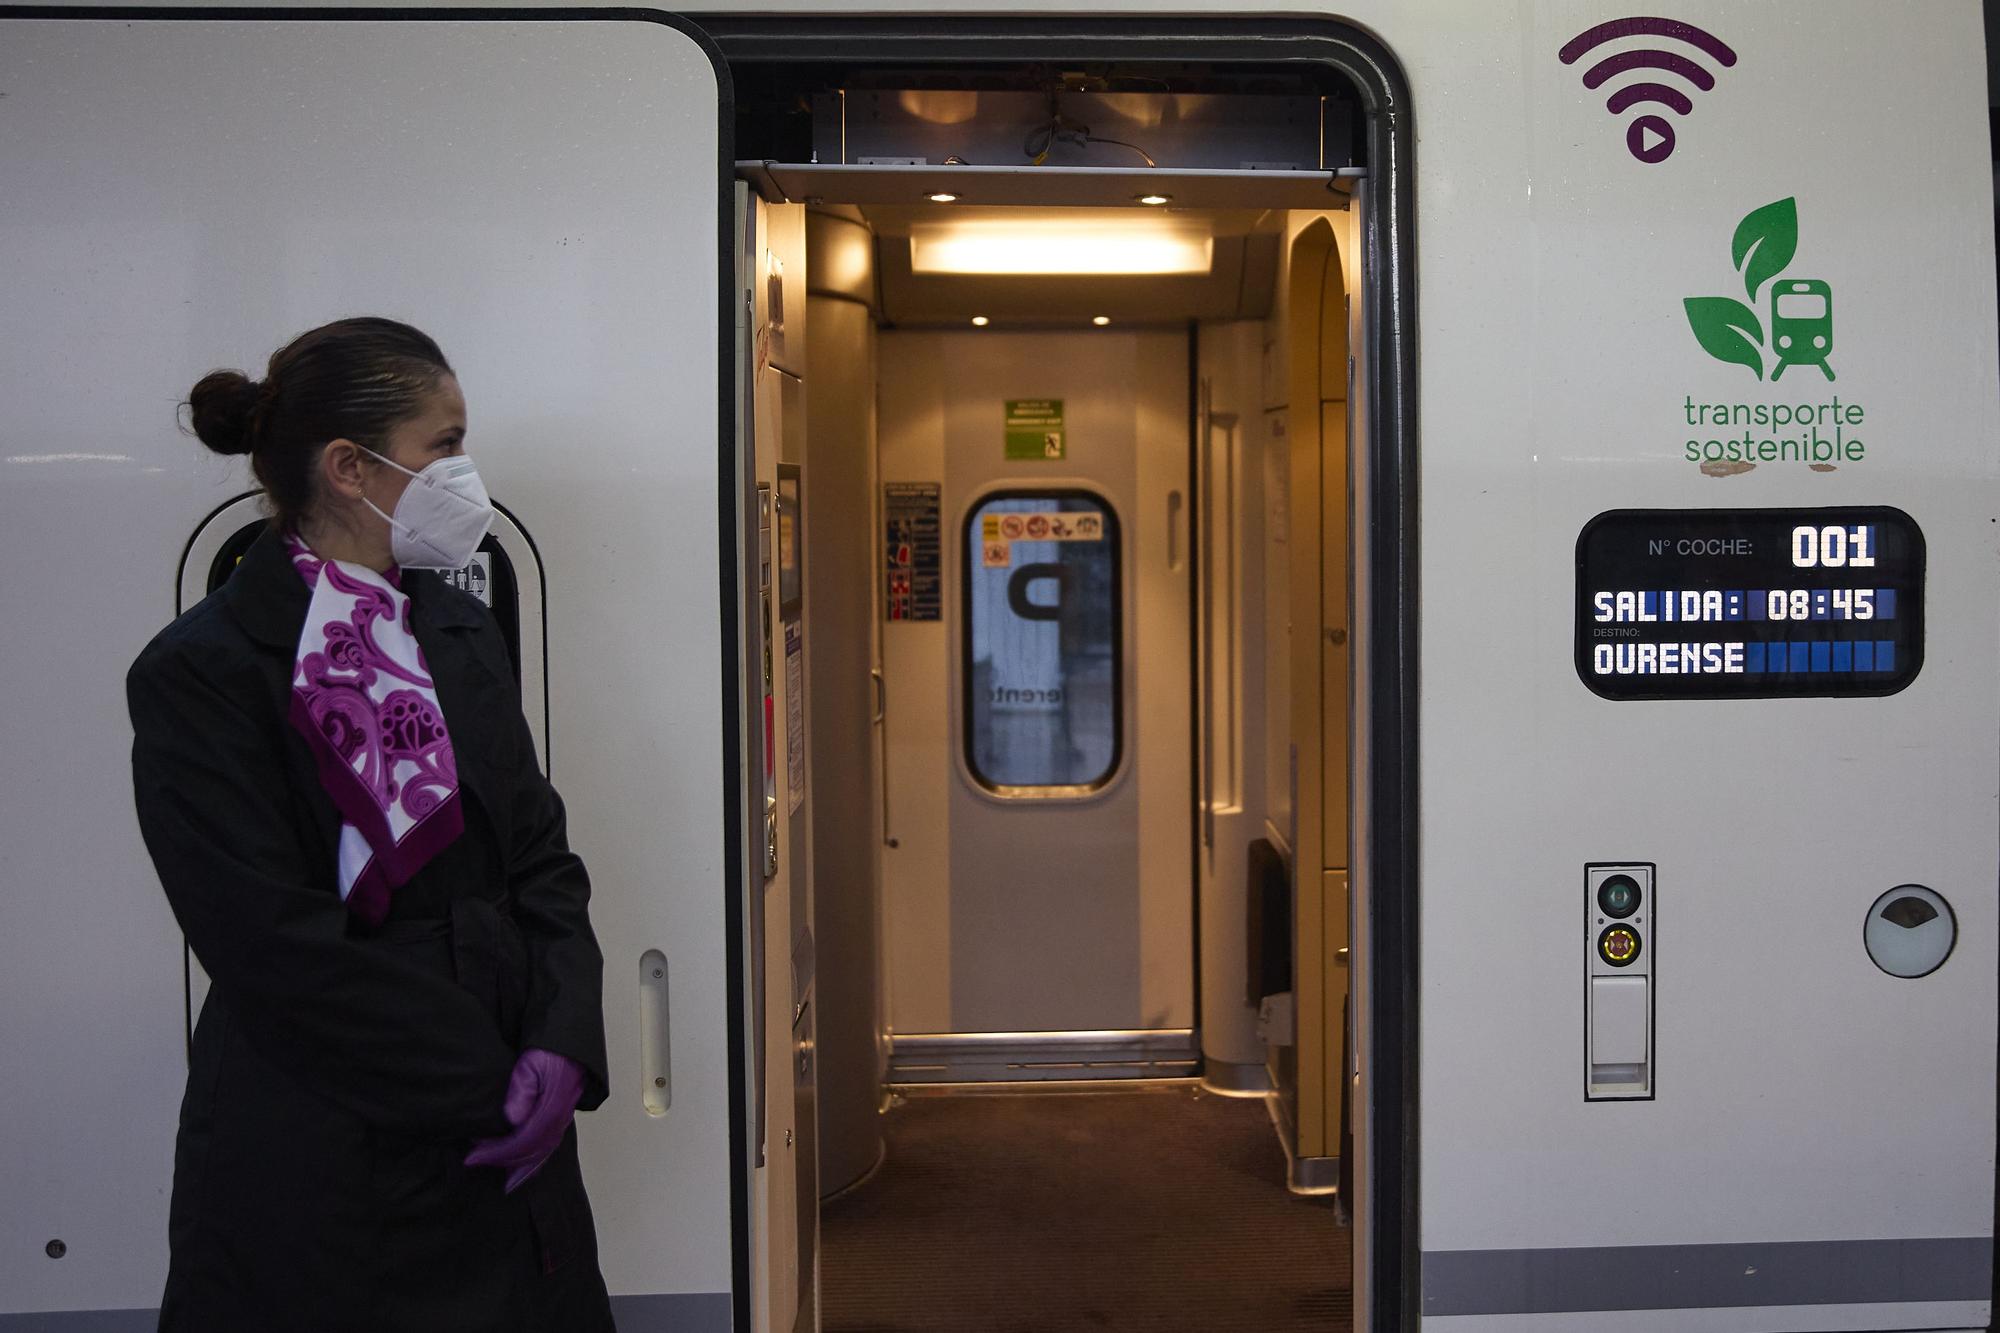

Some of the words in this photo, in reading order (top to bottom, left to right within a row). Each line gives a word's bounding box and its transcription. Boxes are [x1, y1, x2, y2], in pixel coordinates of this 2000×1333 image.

[1684, 396, 1864, 433] transporte
[1685, 427, 1864, 461] sostenible
[1677, 539, 1753, 555] COCHE:
[1793, 525, 1875, 567] 001
[1595, 591, 1738, 622] SALIDA:
[1768, 589, 1874, 621] 08:45
[1593, 628, 1640, 637] DESTINO:
[1595, 642, 1744, 674] OURENSE
